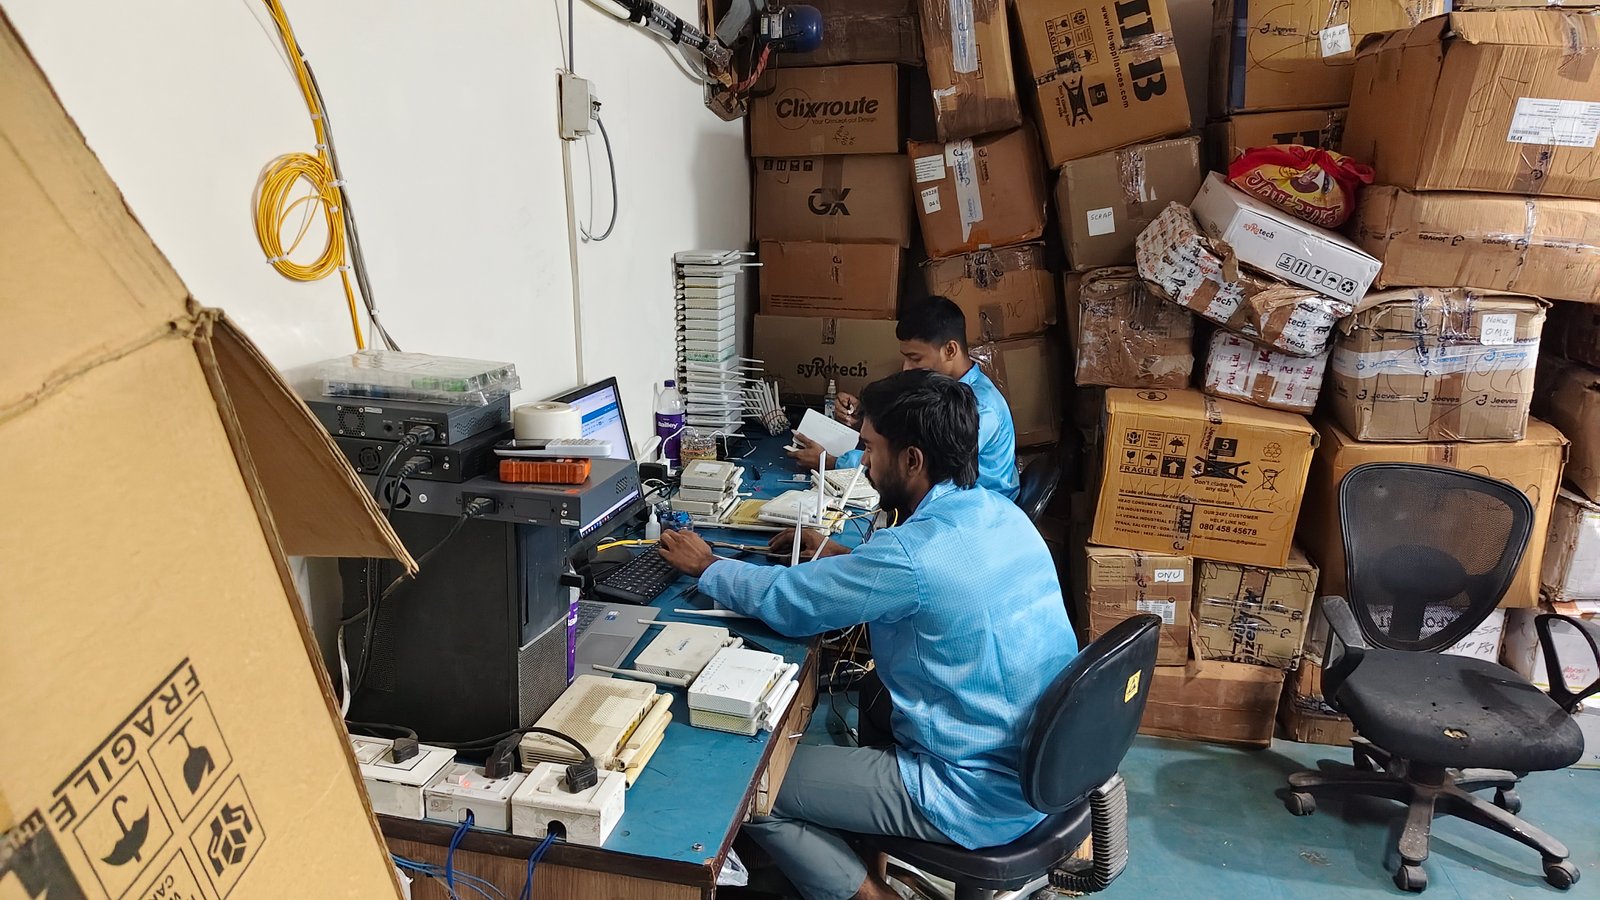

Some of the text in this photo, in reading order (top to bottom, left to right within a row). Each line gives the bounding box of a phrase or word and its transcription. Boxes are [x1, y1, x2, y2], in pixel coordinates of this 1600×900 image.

[775, 96, 879, 118] Clixroute
[1221, 440, 1230, 449] 5
[1120, 465, 1159, 475] FRAGILE
[1199, 523, 1214, 531] 080
[1232, 526, 1257, 536] 45678
[1157, 571, 1181, 581] ONU
[49, 665, 201, 832] FRAGILE
